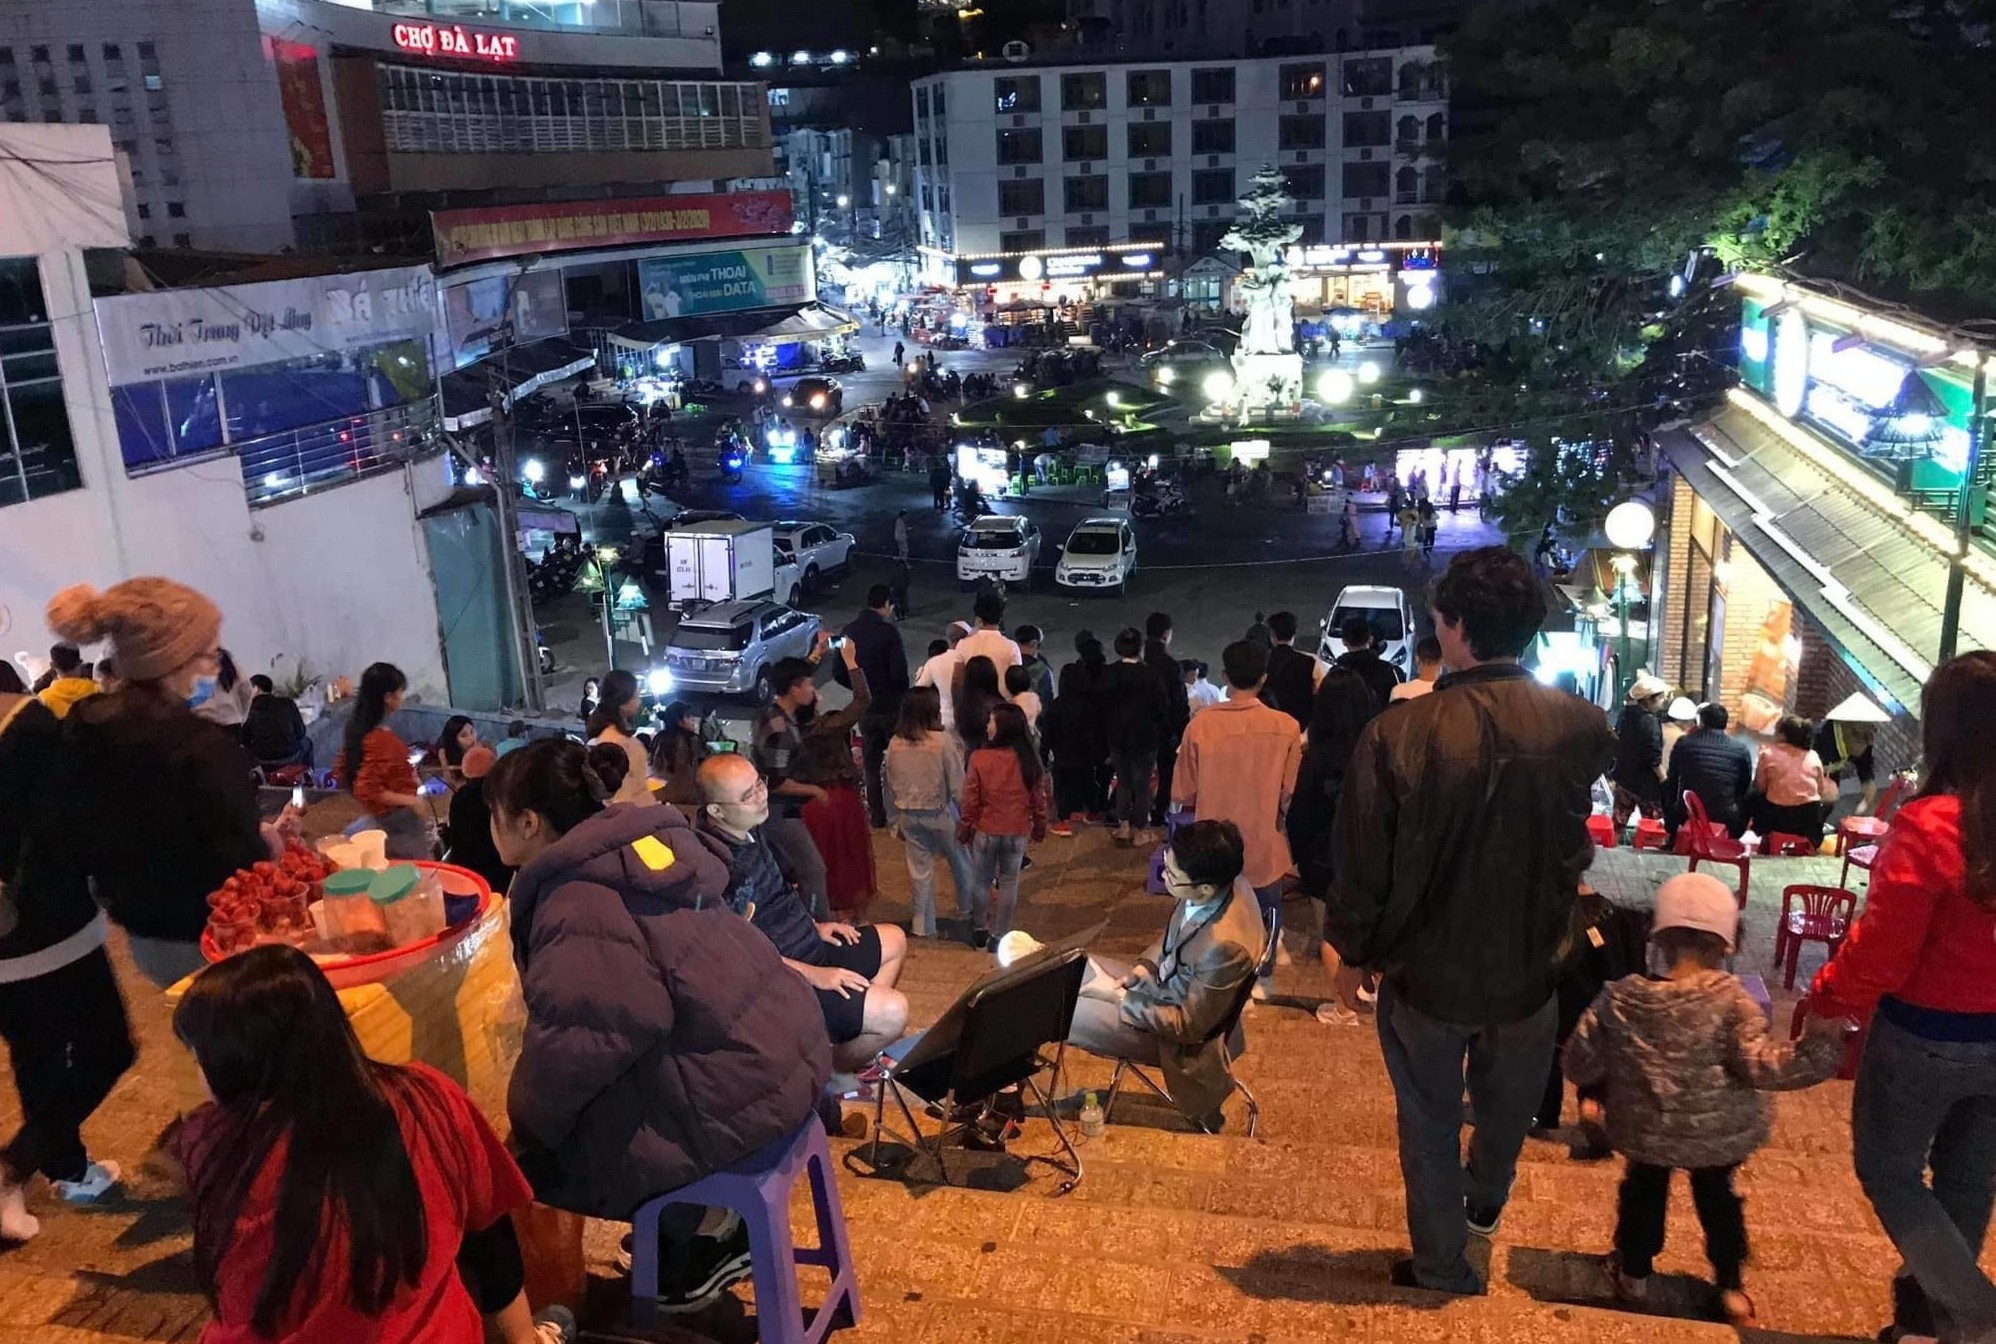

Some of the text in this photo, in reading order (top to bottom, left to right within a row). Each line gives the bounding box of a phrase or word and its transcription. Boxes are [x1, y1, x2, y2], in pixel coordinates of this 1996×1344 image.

[394, 24, 516, 61] CHỢ ĐÀ LẠT
[723, 280, 757, 297] DATA
